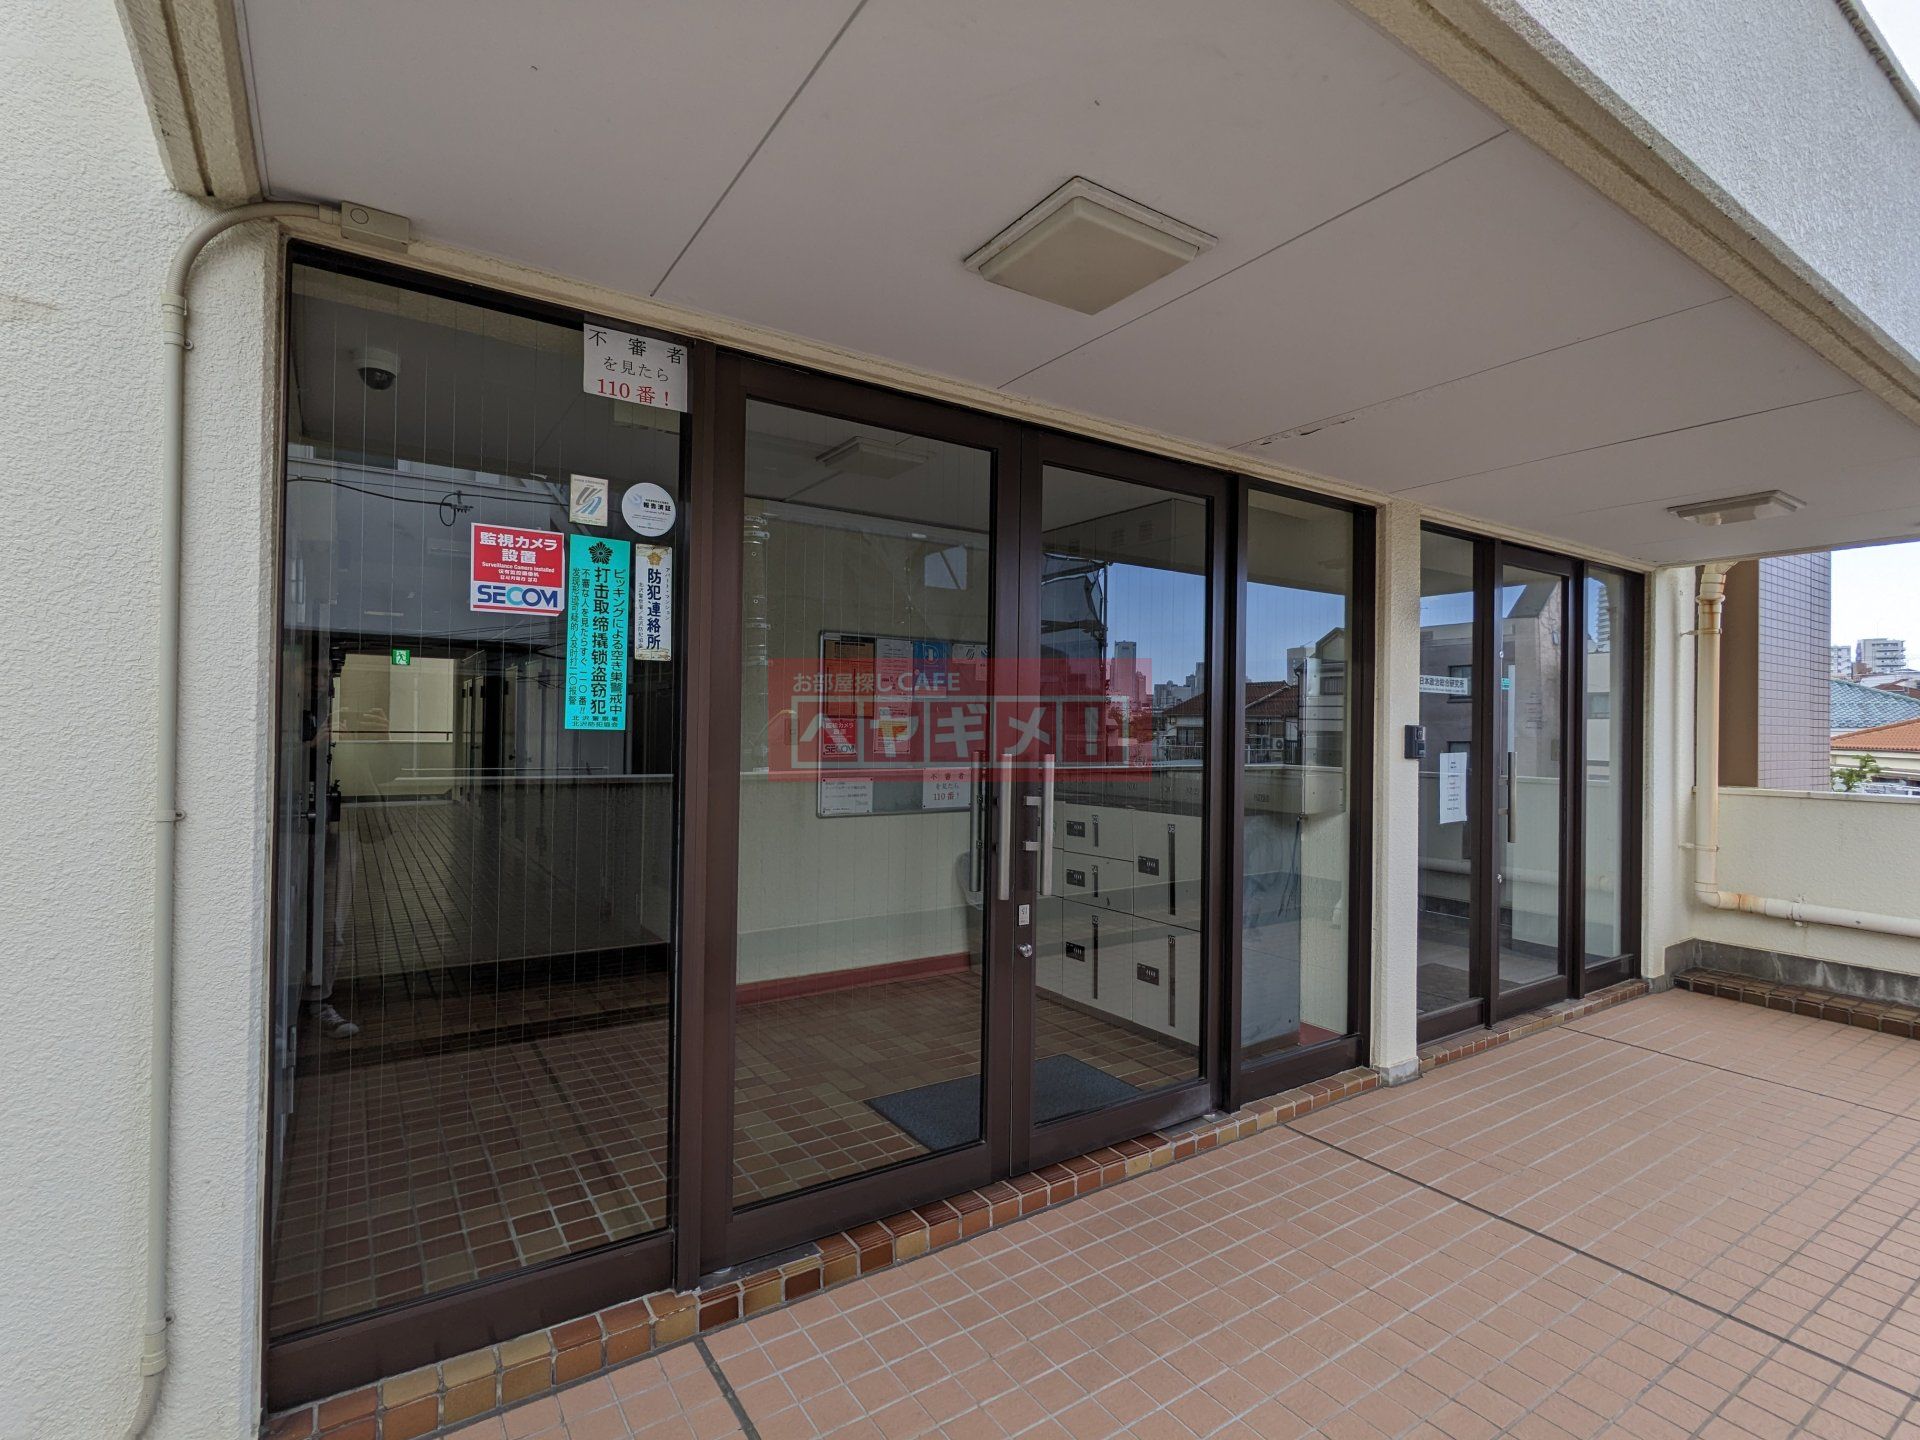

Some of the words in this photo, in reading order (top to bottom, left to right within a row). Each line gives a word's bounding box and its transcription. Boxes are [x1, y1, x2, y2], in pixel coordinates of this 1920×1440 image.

[589, 328, 684, 364] 不審者
[603, 356, 669, 382] を見たら
[643, 501, 671, 512] 報告済証
[479, 531, 558, 551] 監視カメラ
[481, 561, 513, 570] Surveillance
[501, 548, 536, 564] 設置
[477, 584, 558, 608] SECOM
[646, 567, 662, 650] 防犯連絡所
[609, 568, 626, 715] ピッキングによる空き巣警戒中
[824, 744, 855, 754] SECOM
